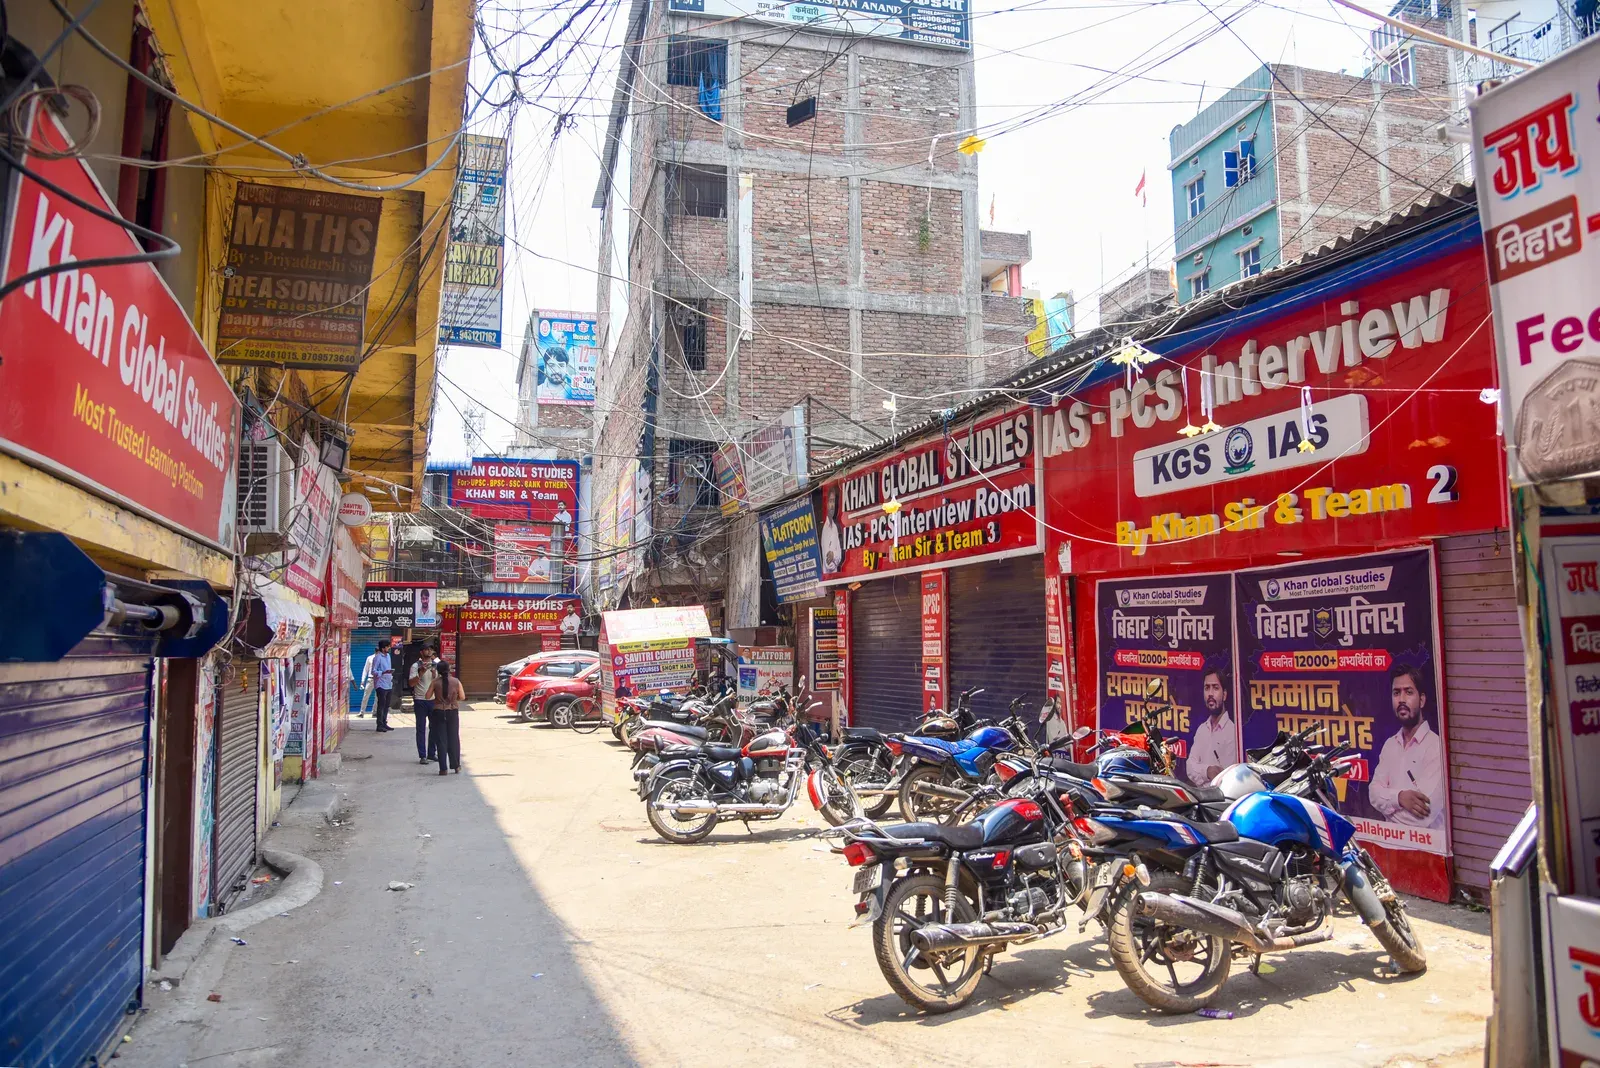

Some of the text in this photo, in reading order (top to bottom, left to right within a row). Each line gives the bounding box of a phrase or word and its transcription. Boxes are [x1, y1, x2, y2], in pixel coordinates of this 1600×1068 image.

[861, 0, 903, 14] ANAND
[1483, 93, 1575, 197] जय
[233, 204, 374, 257] MATHS
[1496, 212, 1574, 271] बिहार
[229, 249, 246, 267] By
[263, 251, 346, 272] Priyadarshi
[349, 261, 370, 274] Sir
[226, 276, 364, 306] REASONING
[224, 313, 260, 327] Daily
[261, 314, 305, 329] Maths
[319, 320, 358, 333] Reas.
[24, 193, 228, 474] Khan Global Studies
[301, 352, 356, 363] 8709573640
[1200, 287, 1451, 410] Interview
[72, 382, 205, 501] Most Trusted Learning Platform
[1151, 412, 1330, 485] KGS IAS
[488, 465, 528, 478] GLOBAL
[531, 467, 574, 479] STUDIES
[841, 470, 877, 513] KHAN
[881, 449, 939, 501] GLOBAL
[945, 413, 1029, 480] STUDIES
[465, 488, 559, 501] KHAN SIR & Team
[544, 481, 568, 489] OTHERS
[343, 502, 363, 510] SAVITRI
[1223, 497, 1269, 533] Sir
[1274, 491, 1303, 526] &
[1303, 481, 1412, 521] Team
[1427, 463, 1459, 505] 2
[339, 508, 366, 516] COMPUTER
[896, 497, 972, 538] Interview
[975, 481, 1032, 520] Room
[771, 512, 814, 544] PLATFORM
[863, 549, 876, 571] By
[915, 535, 932, 557] Sir
[935, 533, 944, 555] &
[945, 527, 983, 551] Team
[987, 521, 997, 543] 3
[1283, 571, 1386, 591] Khan Global Studies
[1562, 561, 1599, 593] जय
[1133, 588, 1203, 600] Khan Global Studies
[1305, 589, 1323, 597] Trusted
[1324, 586, 1349, 595] Learning
[1350, 584, 1376, 592] Platform
[393, 607, 413, 615] ANAND
[470, 599, 514, 611] GLOBAL
[517, 599, 564, 611] STUDIES
[923, 593, 940, 615] BPSC
[444, 611, 455, 619] For
[533, 612, 558, 620] OTHERS
[1255, 596, 1406, 647] बिहार पुलिस
[484, 621, 513, 631] KHAN
[517, 621, 533, 631] SIR
[1111, 608, 1216, 649] बिहार पुलिस
[624, 651, 654, 664] SAVITRI
[655, 647, 695, 661] COMPUTER
[751, 651, 791, 660] PLATFORM
[1138, 652, 1168, 665] 12000+
[1191, 656, 1200, 667] का
[1271, 657, 1293, 668] चयनित
[1294, 654, 1337, 668] 12000+
[1338, 654, 1374, 668] अभ्यर्थियों
[1374, 656, 1386, 668] का
[614, 666, 660, 676] COMPUTER COURSES
[758, 669, 792, 678] New Lucent
[1249, 680, 1341, 712] सम्मान
[1409, 827, 1433, 845] Hat
